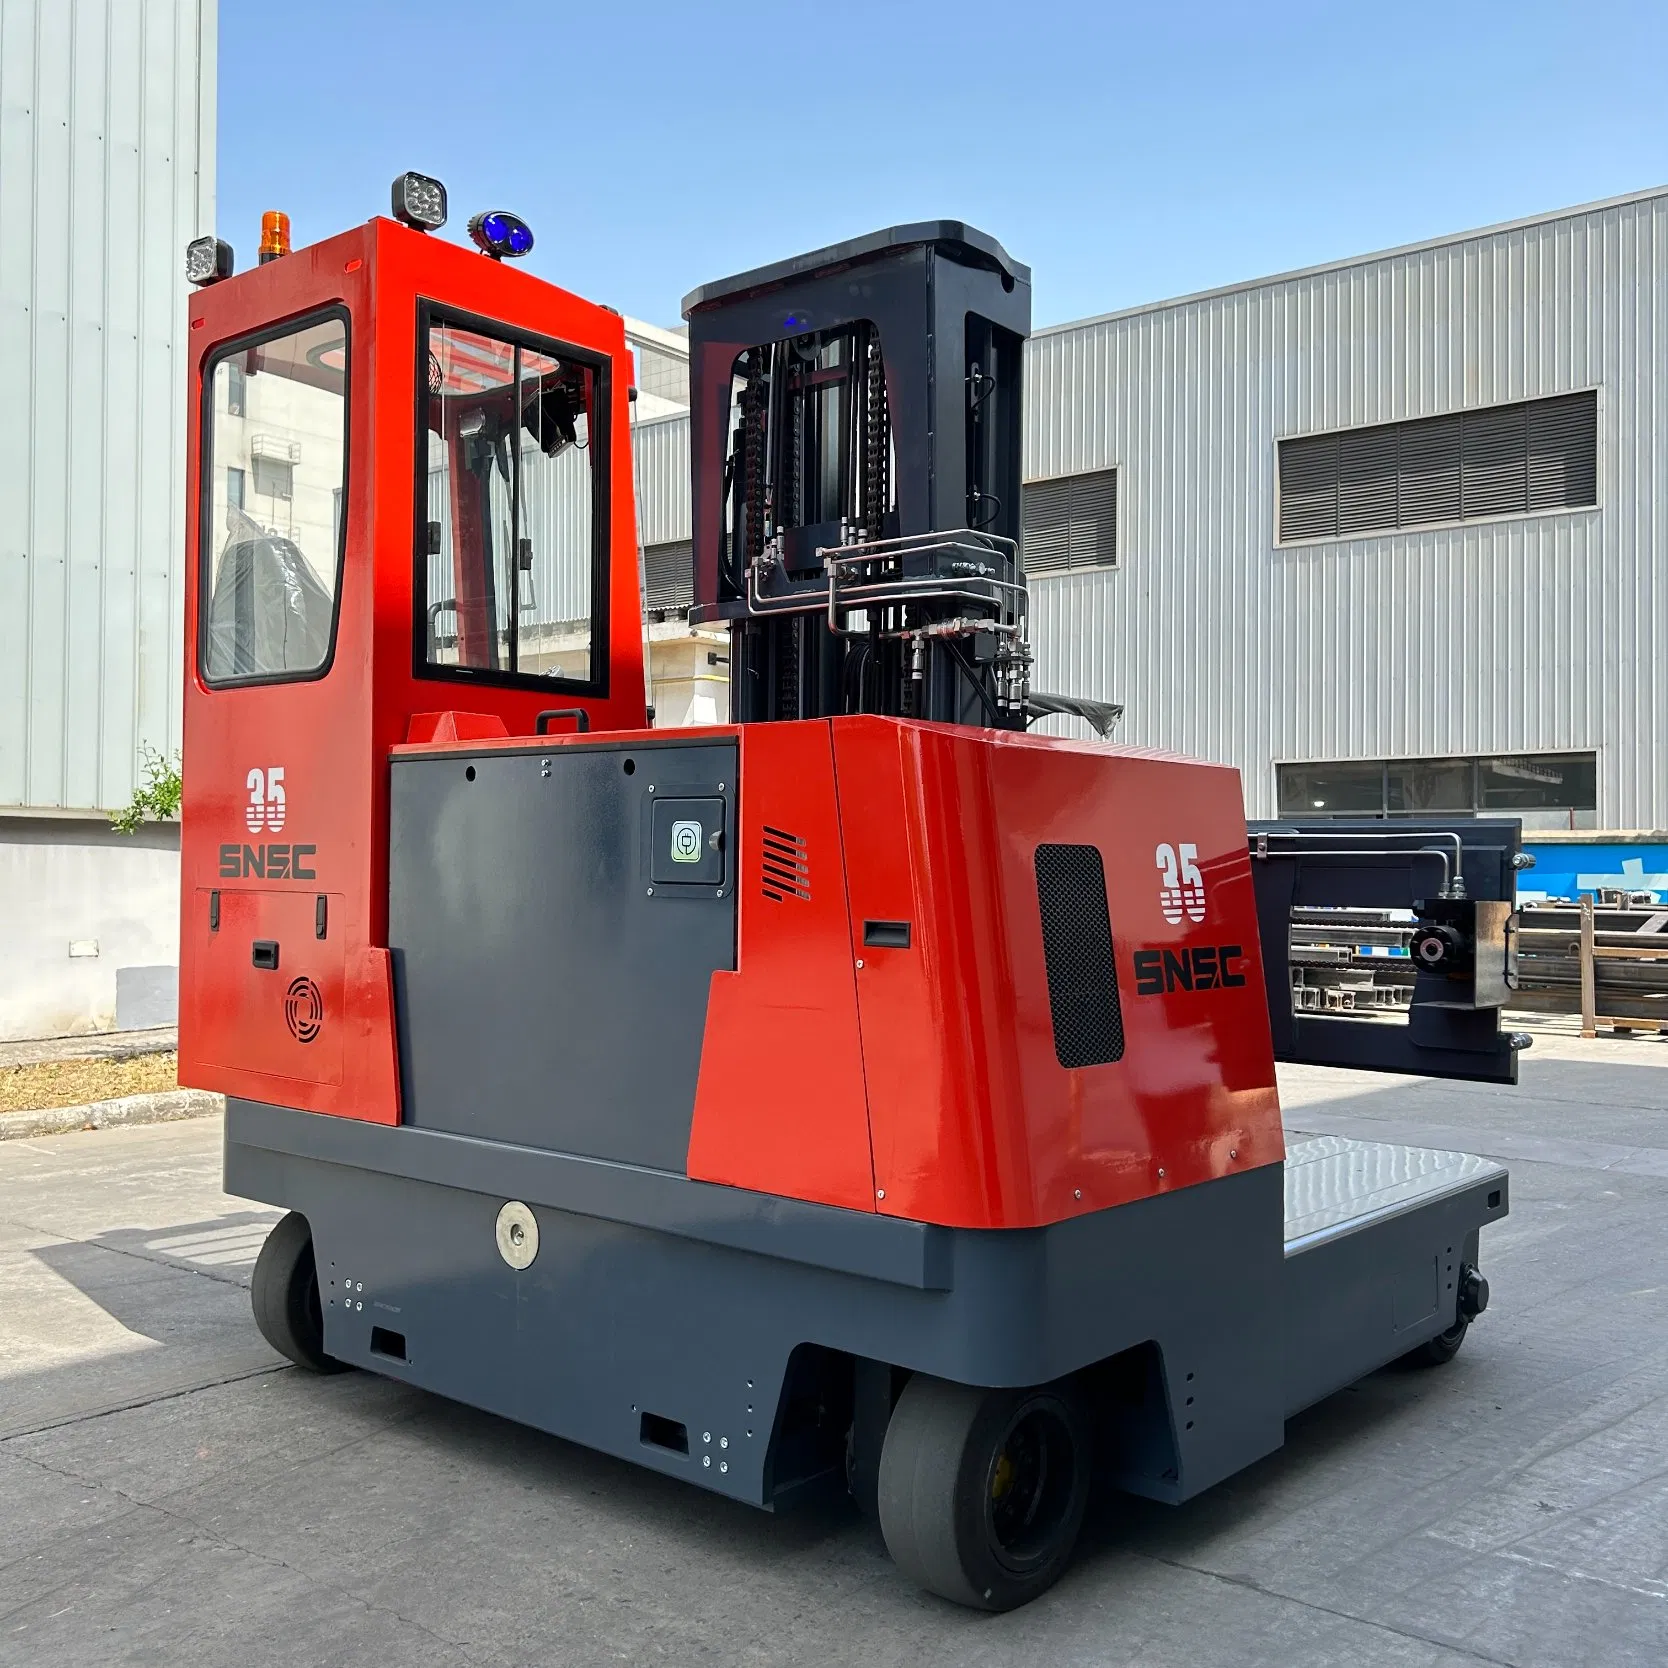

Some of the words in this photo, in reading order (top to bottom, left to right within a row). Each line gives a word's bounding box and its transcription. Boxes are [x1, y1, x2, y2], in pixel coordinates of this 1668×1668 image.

[247, 767, 286, 833] 35
[219, 844, 317, 879] SNSC
[1155, 843, 1206, 925] 35
[1133, 945, 1247, 996] SNSC
